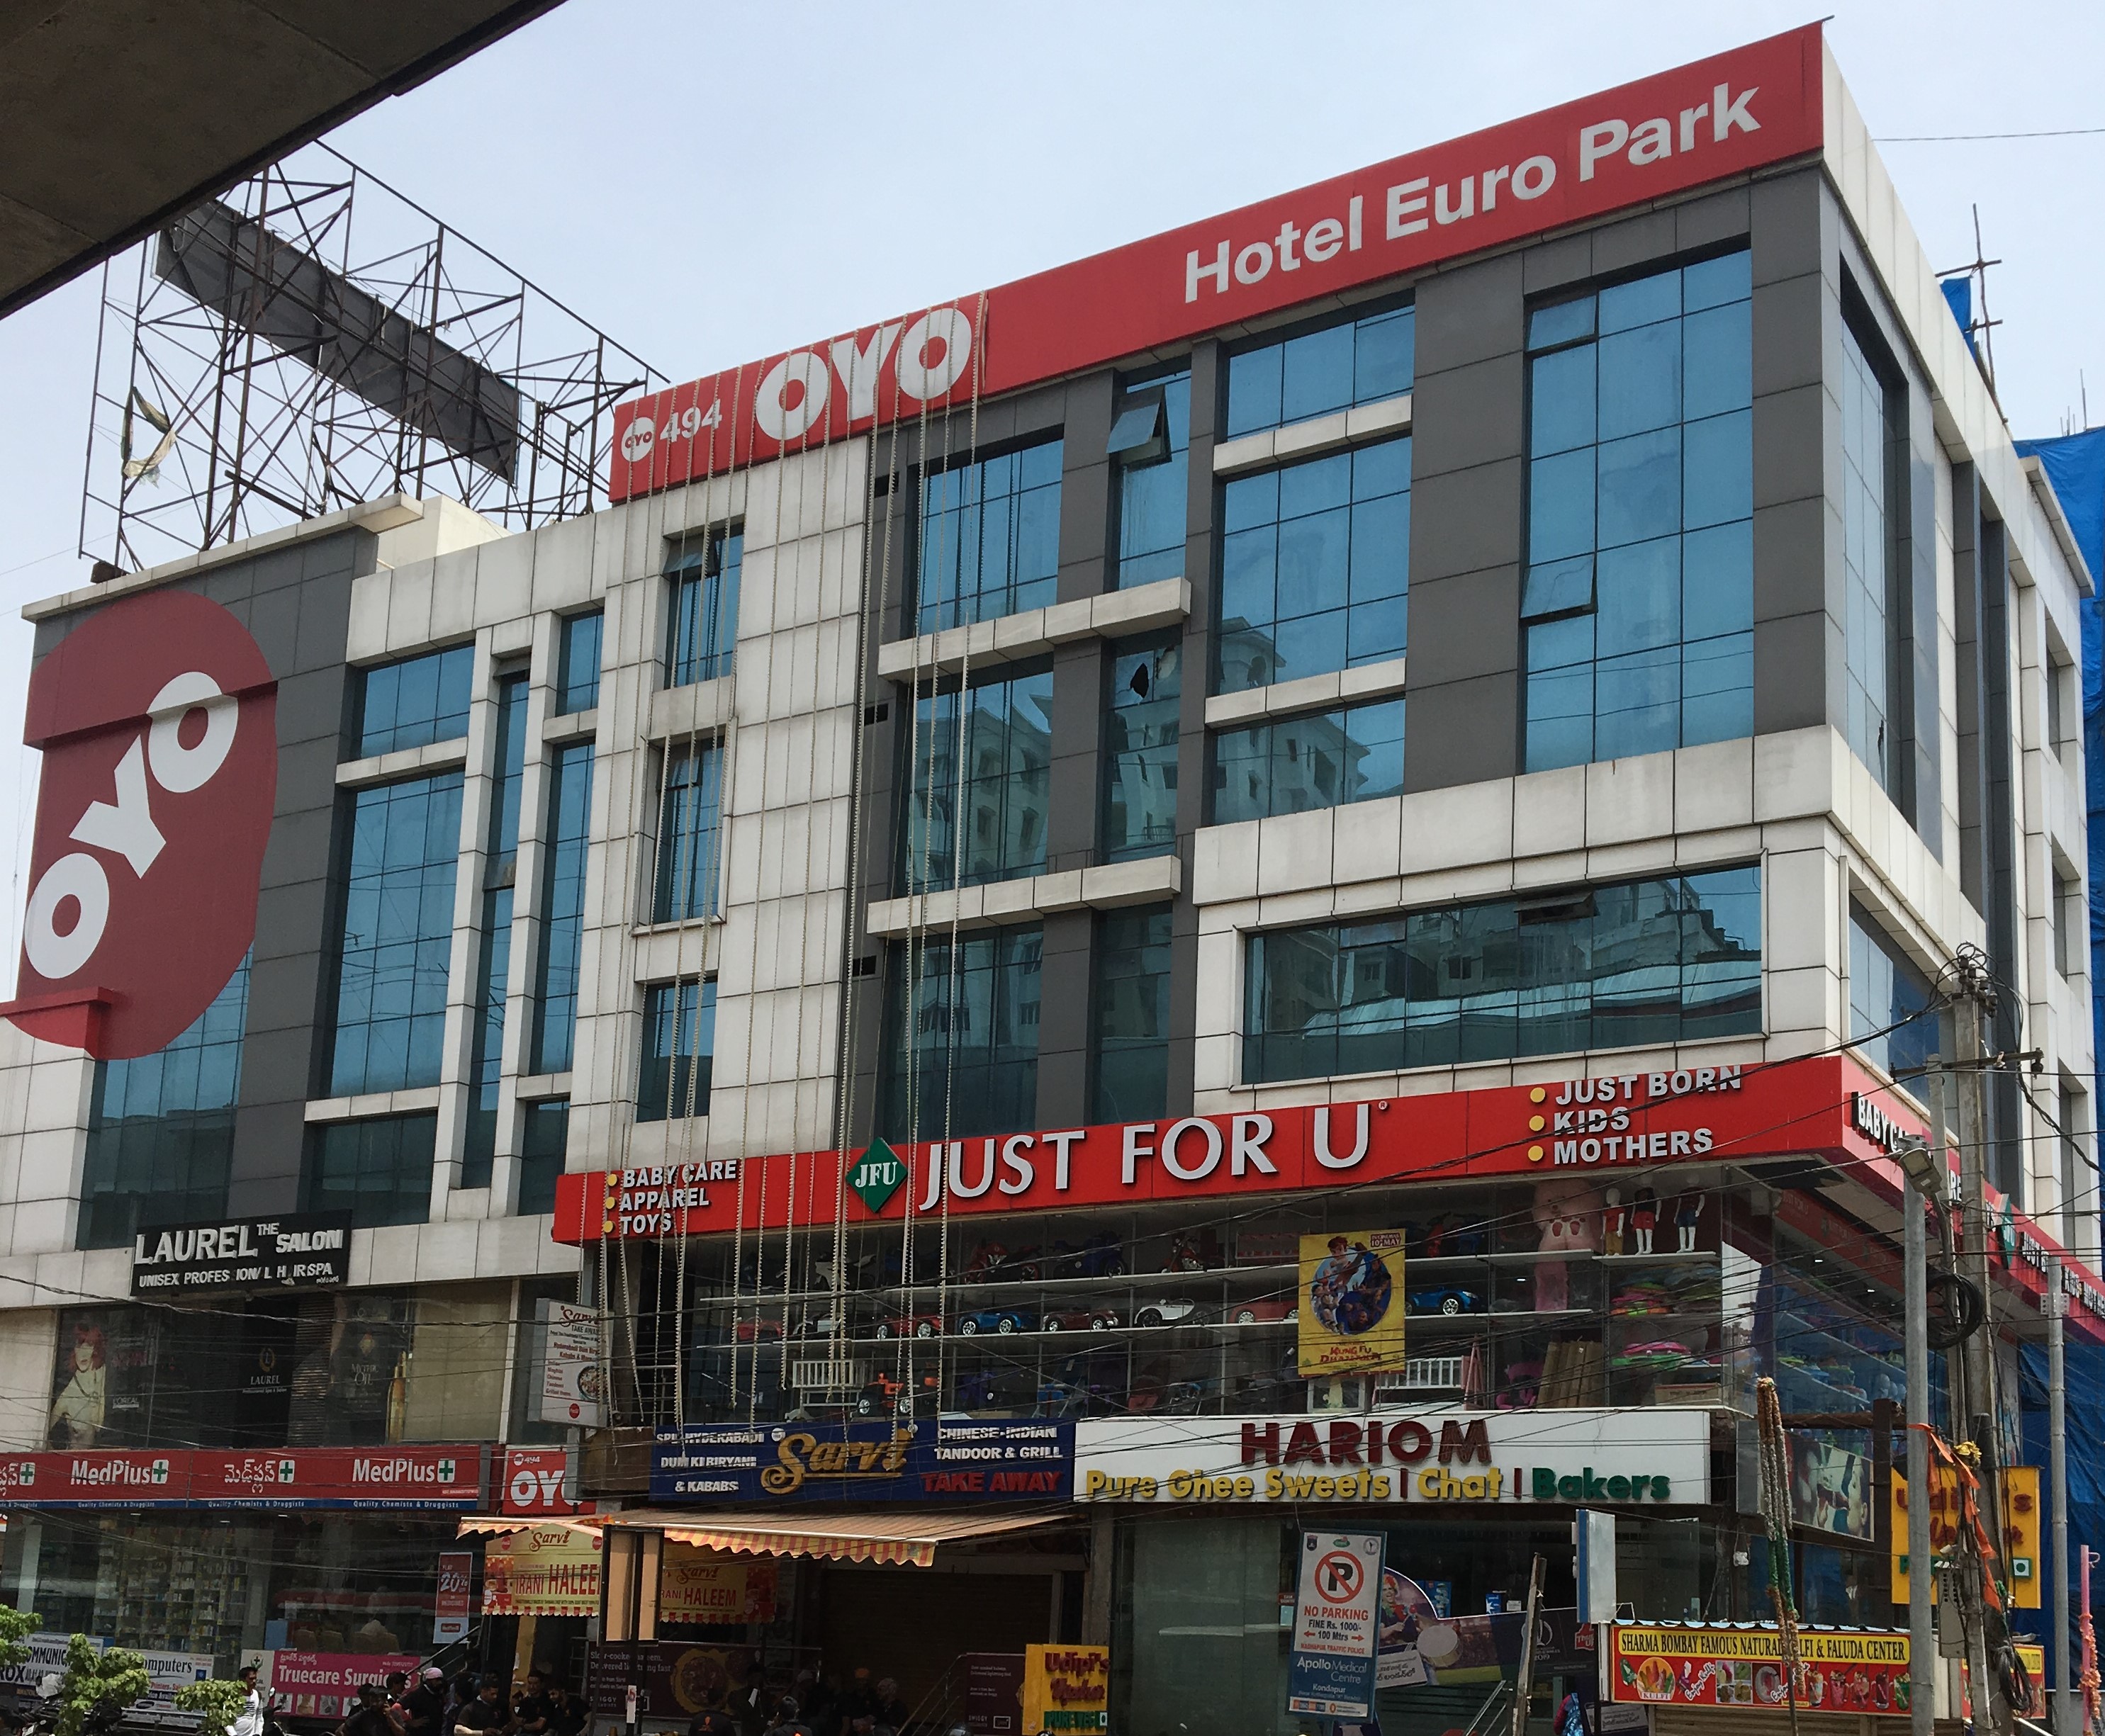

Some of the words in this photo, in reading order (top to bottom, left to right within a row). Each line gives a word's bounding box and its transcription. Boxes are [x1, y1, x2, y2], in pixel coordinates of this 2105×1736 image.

[1185, 194, 1364, 304] Hotel
[1385, 155, 1557, 242] Euro
[1579, 82, 1763, 183] Park
[756, 307, 972, 441] OYO
[624, 429, 653, 450] OYO
[659, 398, 723, 443] 494
[24, 671, 239, 980] OYO
[1555, 1073, 1638, 1105] JUST
[1648, 1064, 1741, 1098] BORN
[1554, 1106, 1630, 1137] KIDS
[1858, 1091, 1889, 1146] BABY
[919, 1129, 1086, 1211] JUST
[1121, 1113, 1278, 1185] FOR
[1313, 1103, 1369, 1168] U
[1554, 1127, 1713, 1165] MOTHERS
[622, 1165, 674, 1188] BABY
[681, 1159, 737, 1183] CARE
[855, 1161, 897, 1188] JFU
[619, 1187, 709, 1212] APPAREL
[620, 1212, 672, 1234] TOYS
[134, 1224, 258, 1266] LAUREL
[256, 1222, 281, 1236] THE
[276, 1229, 344, 1253] SALON
[1382, 1239, 1400, 1247] MAY
[139, 1273, 179, 1287] UNISEX
[308, 1262, 332, 1275] SPA
[571, 1324, 584, 1333] TAKE
[250, 1375, 281, 1386] LAUREL
[934, 1446, 1002, 1461] TANDOOR
[1004, 1447, 1015, 1460] &
[1016, 1445, 1062, 1460] GRILL
[1240, 1419, 1493, 1465] HARIOM
[71, 1460, 151, 1486] MedPlus
[352, 1458, 435, 1482] MedPlus
[760, 1427, 915, 1495] Sarvi
[675, 1480, 686, 1492] &
[687, 1479, 739, 1493] KABABS
[923, 1471, 986, 1492] TAKE
[991, 1470, 1061, 1491] AWAY
[1086, 1469, 1158, 1499] Pure
[1168, 1468, 1254, 1499] Ghee
[1264, 1467, 1391, 1499] Sweets
[1418, 1465, 1504, 1499] Chat
[1532, 1467, 1671, 1501] Bakers
[353, 1500, 379, 1509] Quality
[425, 1501, 459, 1509] Druggists
[529, 1529, 571, 1552] Sarvi
[515, 1574, 545, 1595] IRANI
[548, 1564, 600, 1595] HALEE
[676, 1566, 719, 1584] Sarvi
[661, 1589, 682, 1599] RANI
[683, 1587, 737, 1607] HALEEM
[1304, 1606, 1318, 1617] NO
[1321, 1606, 1369, 1621] PARKING
[1308, 1619, 1325, 1629] FINE
[1326, 1620, 1338, 1630] Rs.
[1340, 1621, 1362, 1632] 1000/-
[1318, 1630, 1332, 1640] 100
[1333, 1631, 1349, 1642] Mtrs
[1622, 1633, 1659, 1652] SHARMA
[1661, 1635, 1698, 1654] BOMBAY
[1700, 1635, 1738, 1655] FAMOUS
[1740, 1637, 1783, 1657] NATURAL
[1817, 1641, 1825, 1658] &
[1826, 1641, 1865, 1659] FALUDA
[1866, 1642, 1906, 1661] CENTER
[143, 1658, 192, 1675] omputers
[278, 1664, 344, 1686] Truecare
[344, 1667, 412, 1689] Surgics
[1296, 1656, 1331, 1674] Apollo
[1331, 1659, 1367, 1674] Medical
[1330, 1671, 1362, 1684] Centre
[1313, 1683, 1346, 1695] Kondapur
[1044, 1710, 1075, 1729] PURE
